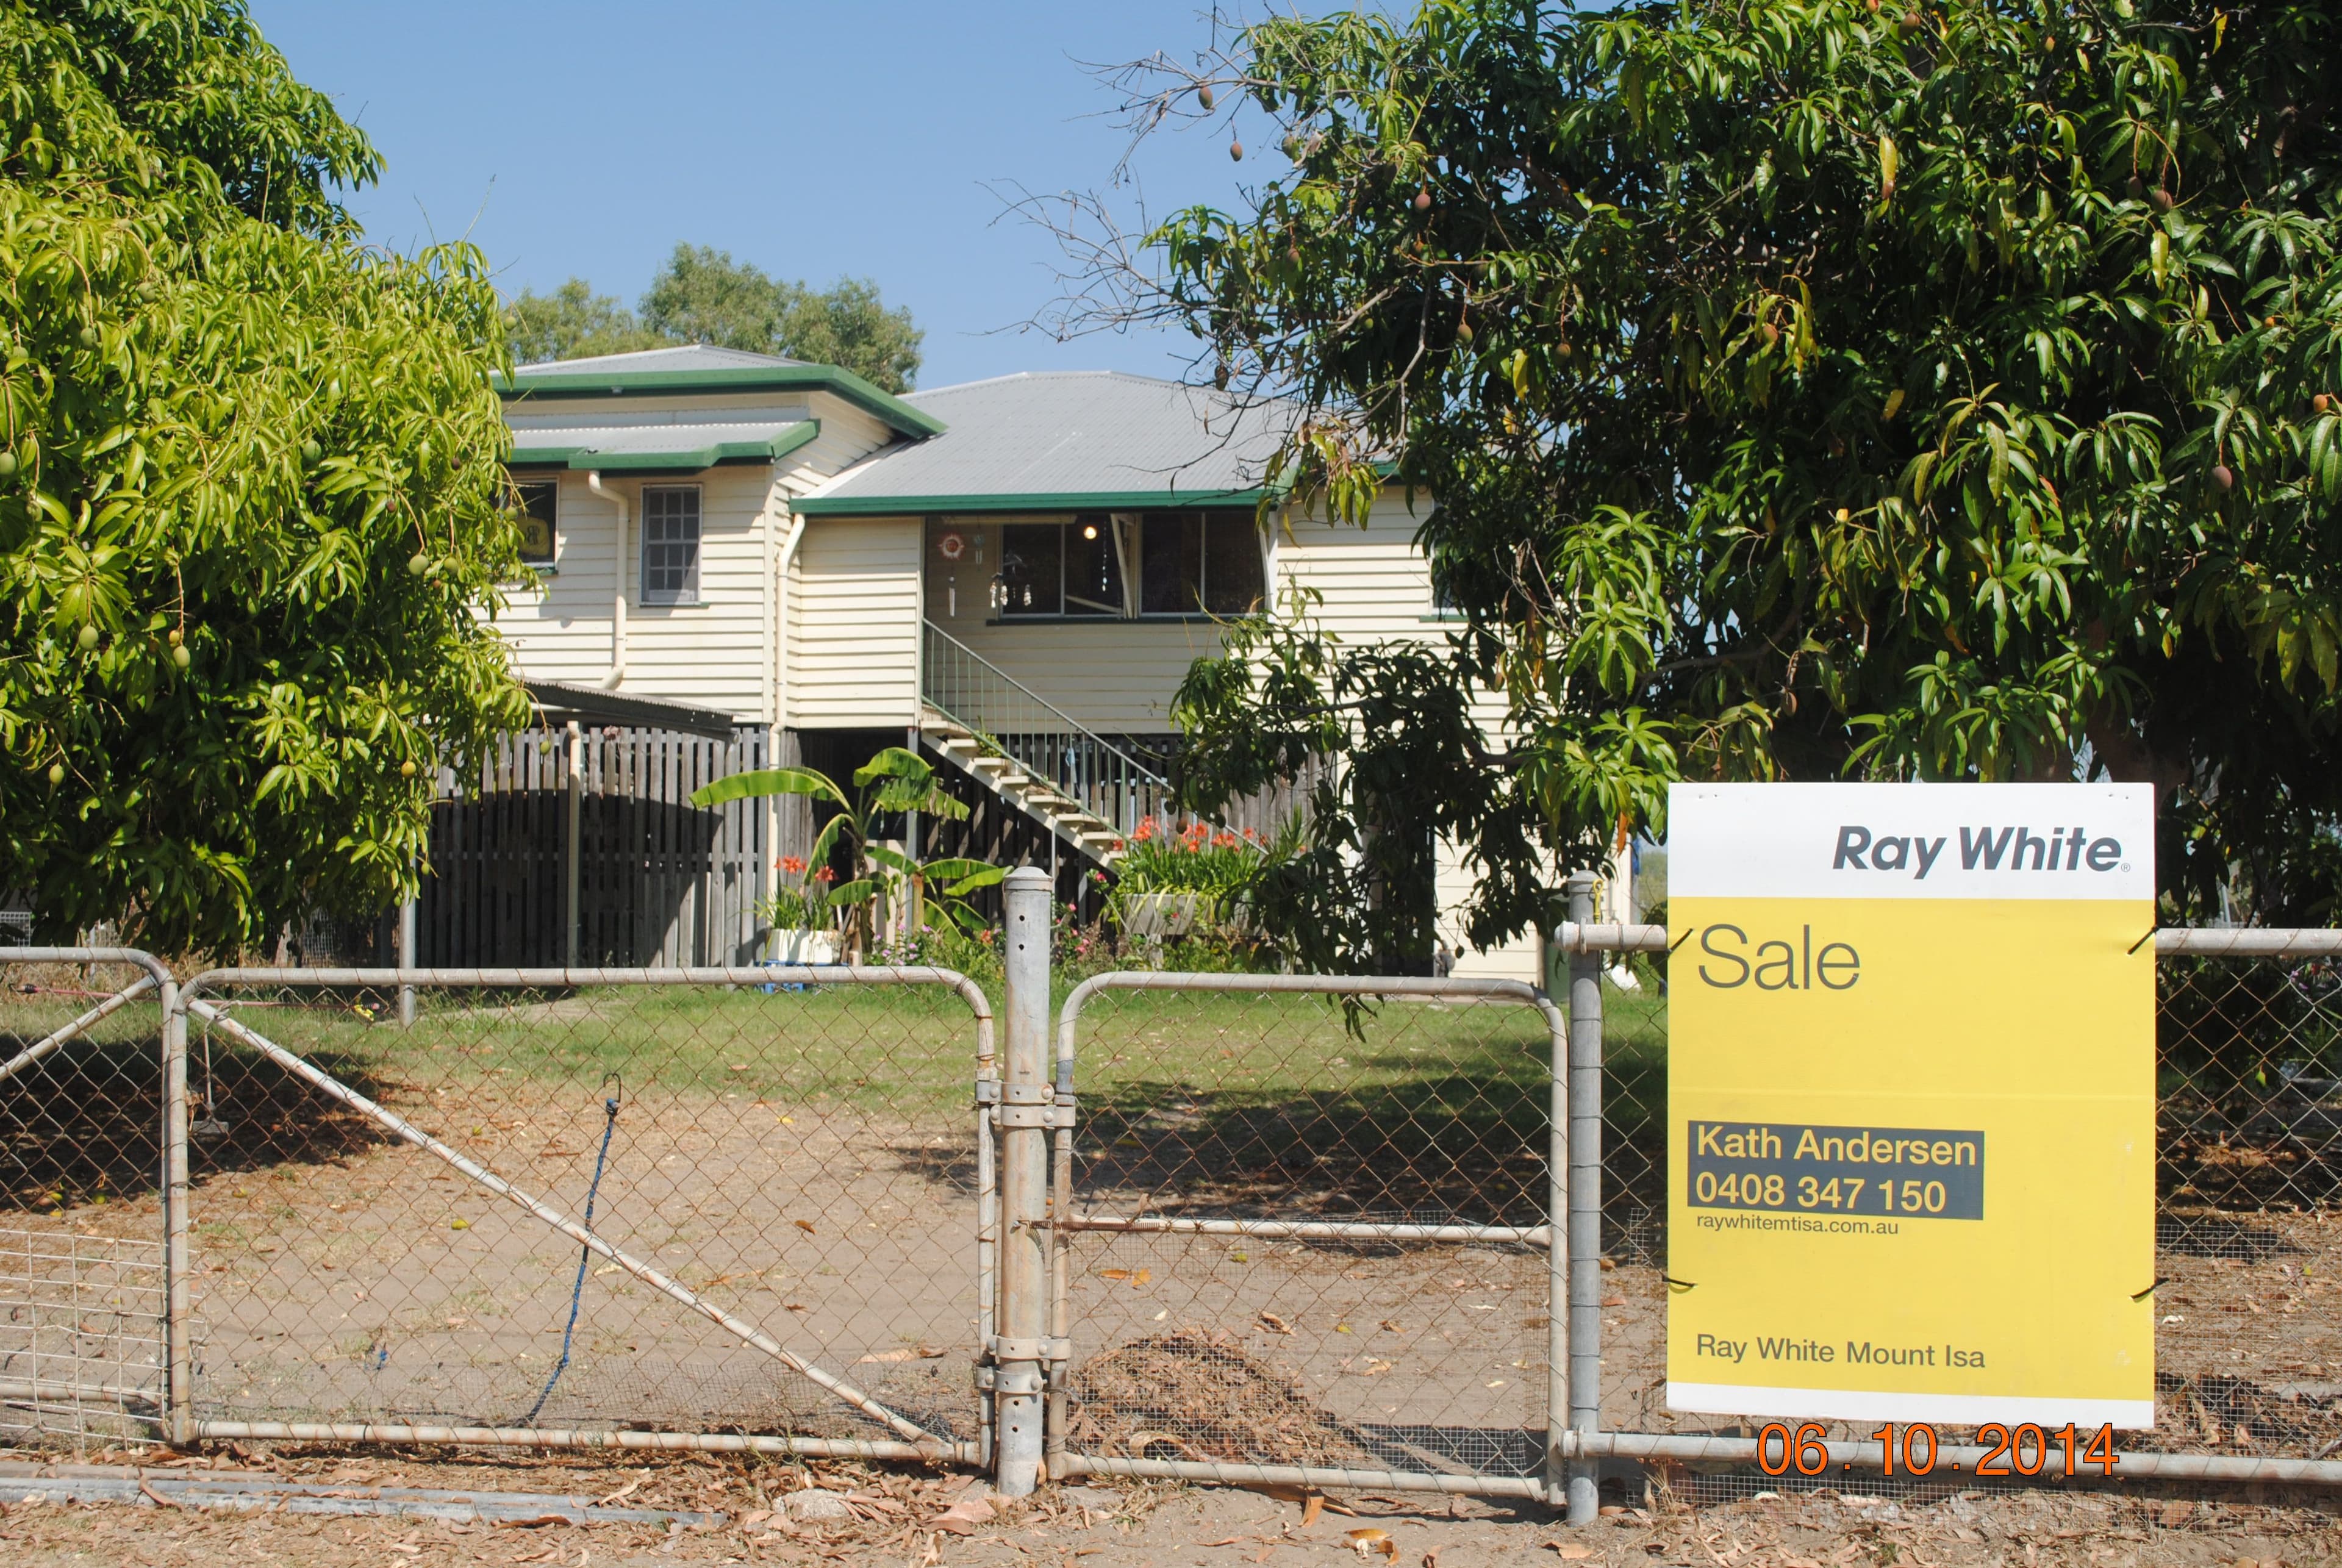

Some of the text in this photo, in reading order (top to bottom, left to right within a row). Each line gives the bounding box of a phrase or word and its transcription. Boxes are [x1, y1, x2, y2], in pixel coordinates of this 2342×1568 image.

[1833, 825, 2122, 879] Ray White
[1699, 923, 1860, 990] Sale
[1697, 1125, 1976, 1166] Kath Andersen
[1696, 1171, 1946, 1213] 0408 347 150
[1697, 1214, 1899, 1235] raywhitemtisa.com.au
[1697, 1333, 1986, 1368] Ray White Mount Isa
